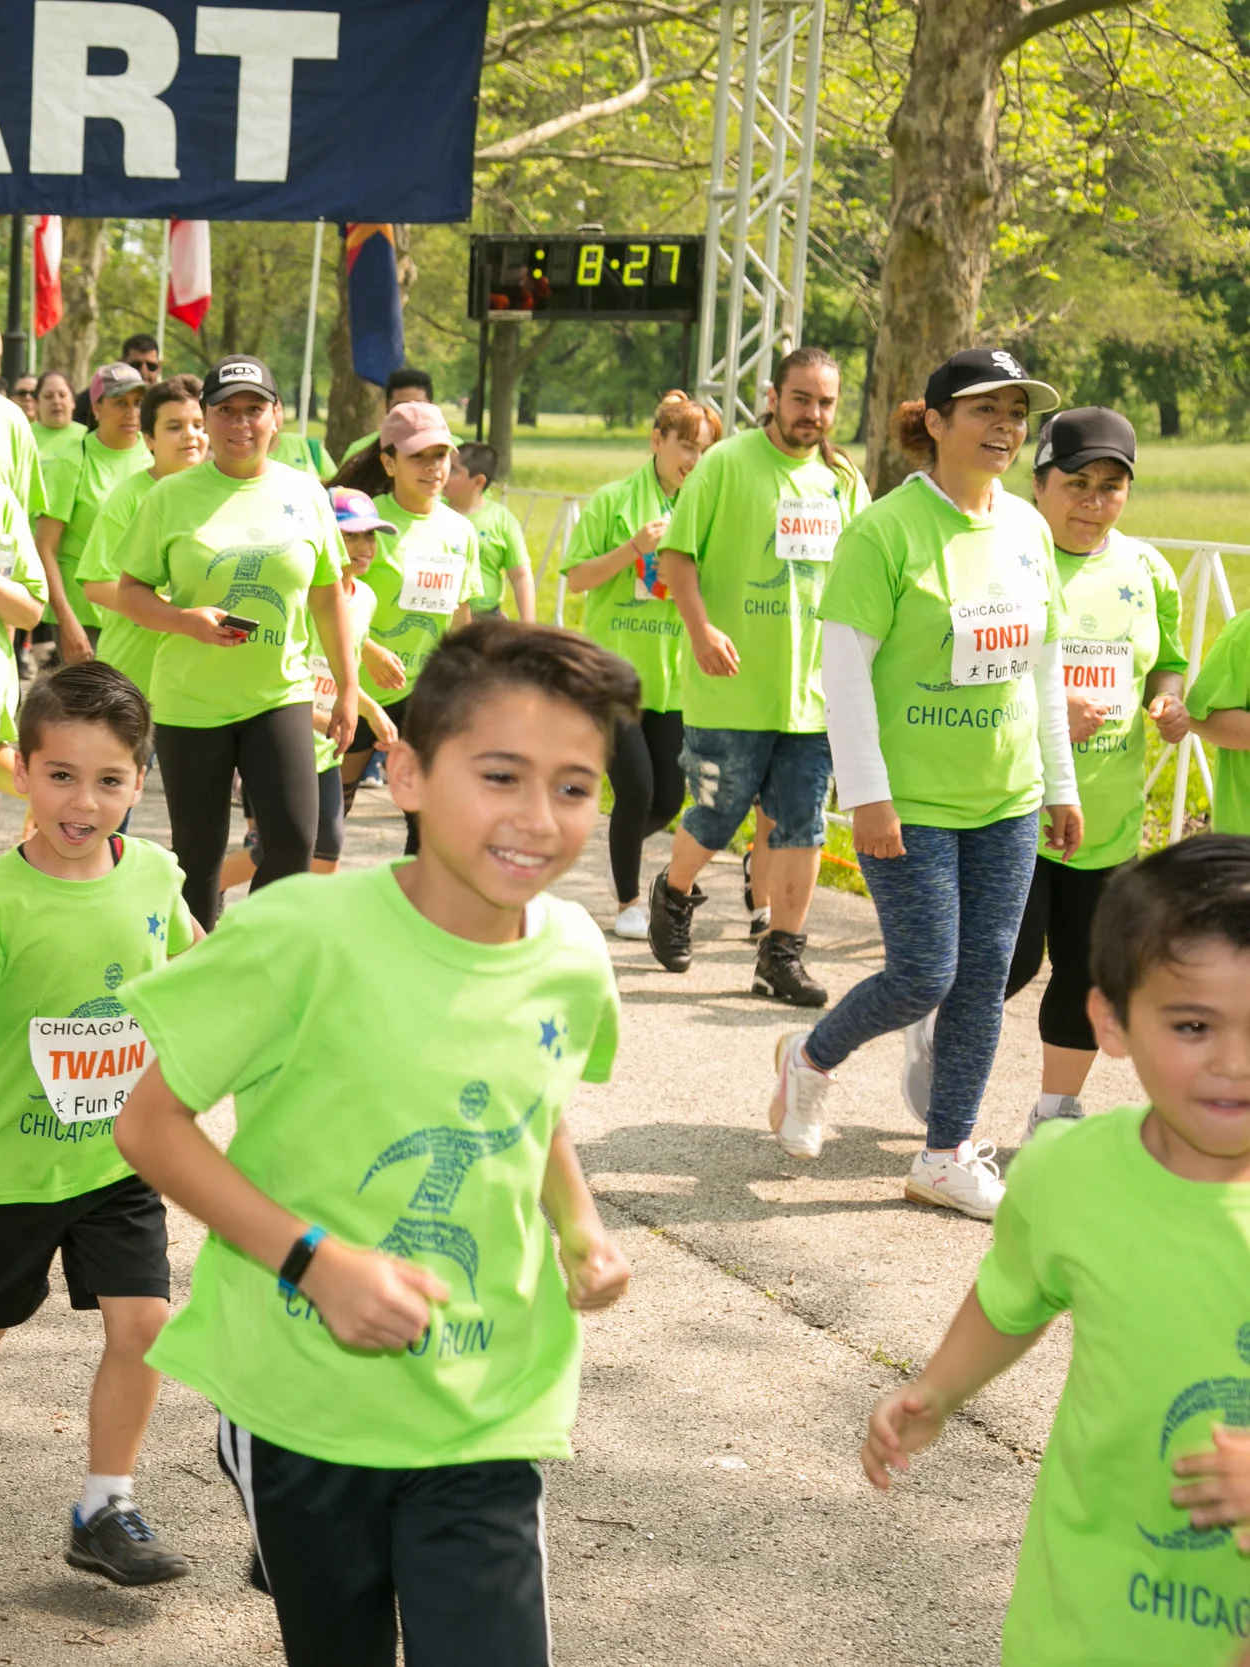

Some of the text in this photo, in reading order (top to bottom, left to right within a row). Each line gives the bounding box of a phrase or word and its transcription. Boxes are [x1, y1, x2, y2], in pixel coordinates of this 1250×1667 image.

[779, 516, 839, 537] SAWYER
[417, 570, 454, 590] TONTI
[958, 603, 1014, 618] CHICAGO
[263, 629, 286, 647] RU
[973, 623, 1030, 652] TONTI
[1061, 643, 1128, 656] HICAGO RUN
[987, 659, 1028, 680] Fun Run
[1063, 665, 1116, 688] TONTI
[906, 705, 1002, 729] CHICAGO
[1106, 704, 1122, 716] un
[40, 1020, 124, 1036] CHICAGO
[49, 1039, 146, 1081] TWAIN
[74, 1095, 108, 1116] Fun
[439, 1319, 494, 1359] RUN
